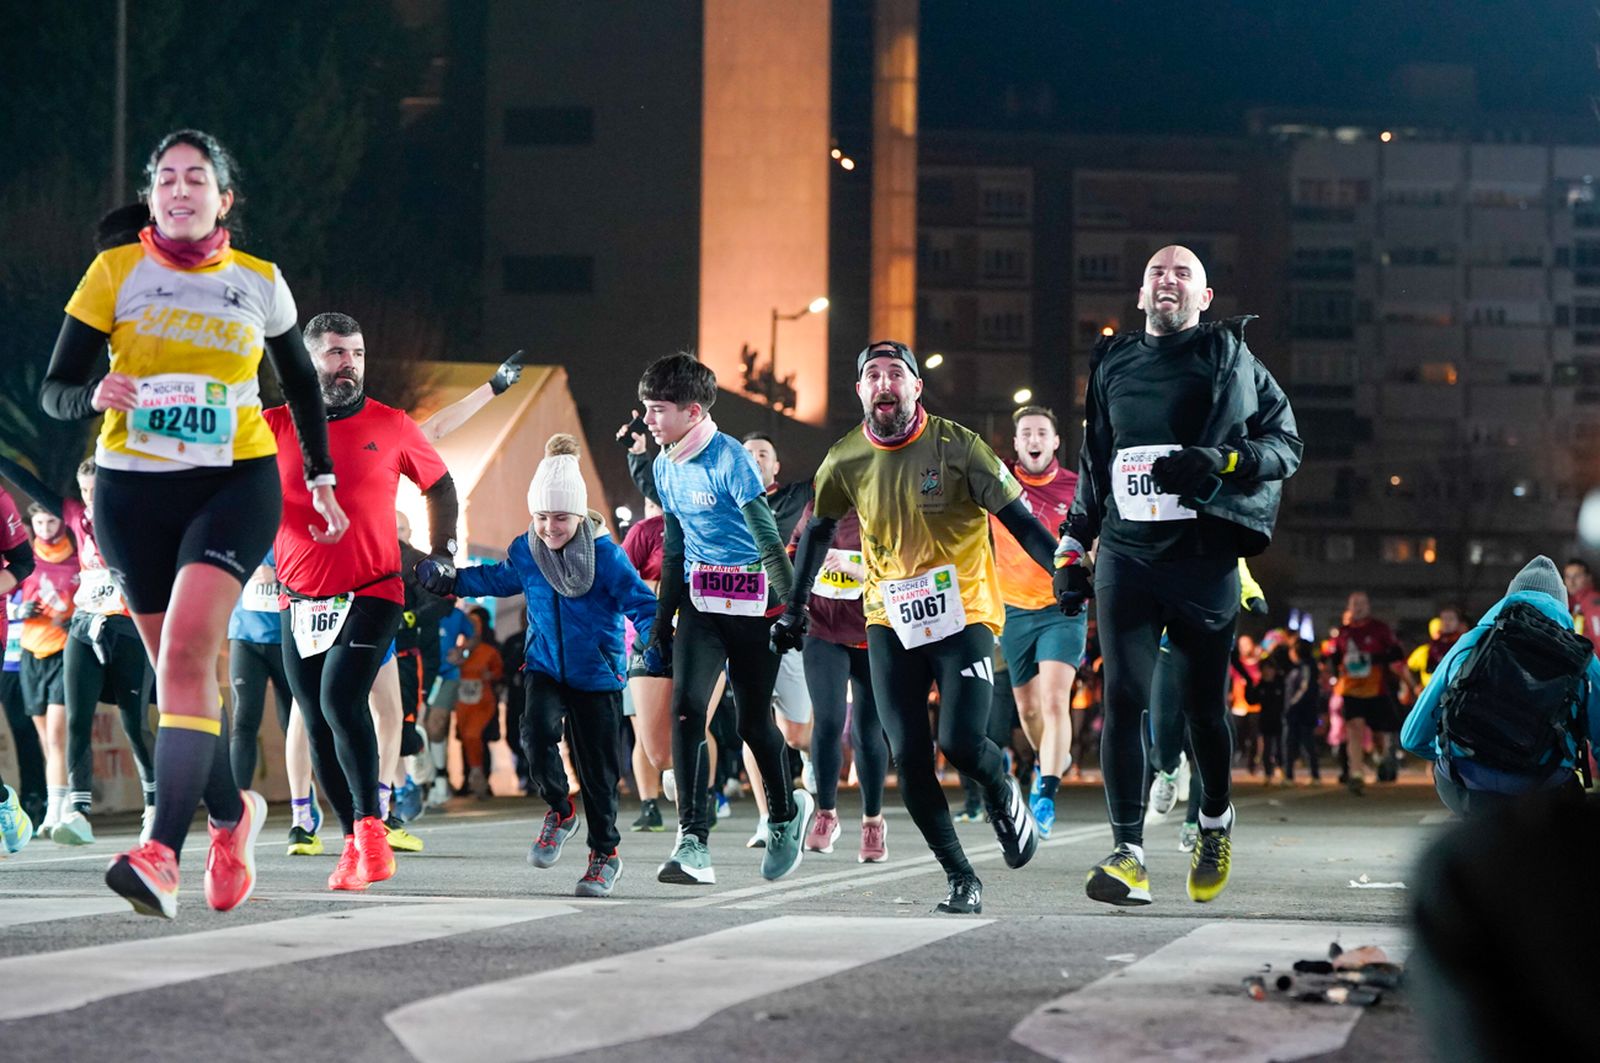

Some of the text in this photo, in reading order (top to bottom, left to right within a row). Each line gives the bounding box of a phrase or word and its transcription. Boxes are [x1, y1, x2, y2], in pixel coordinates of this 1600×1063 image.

[142, 303, 255, 345] LIEBRES
[153, 383, 195, 394] NOCHE DE
[142, 398, 161, 407] SAN
[149, 405, 217, 435] 8240
[1121, 464, 1136, 473] SAN
[1127, 473, 1161, 496] 50
[698, 563, 713, 572] SAN
[699, 571, 760, 593] 15025
[897, 580, 919, 592] NOCHE
[920, 578, 929, 588] DE
[891, 594, 905, 604] SAN
[899, 592, 946, 624] 5067
